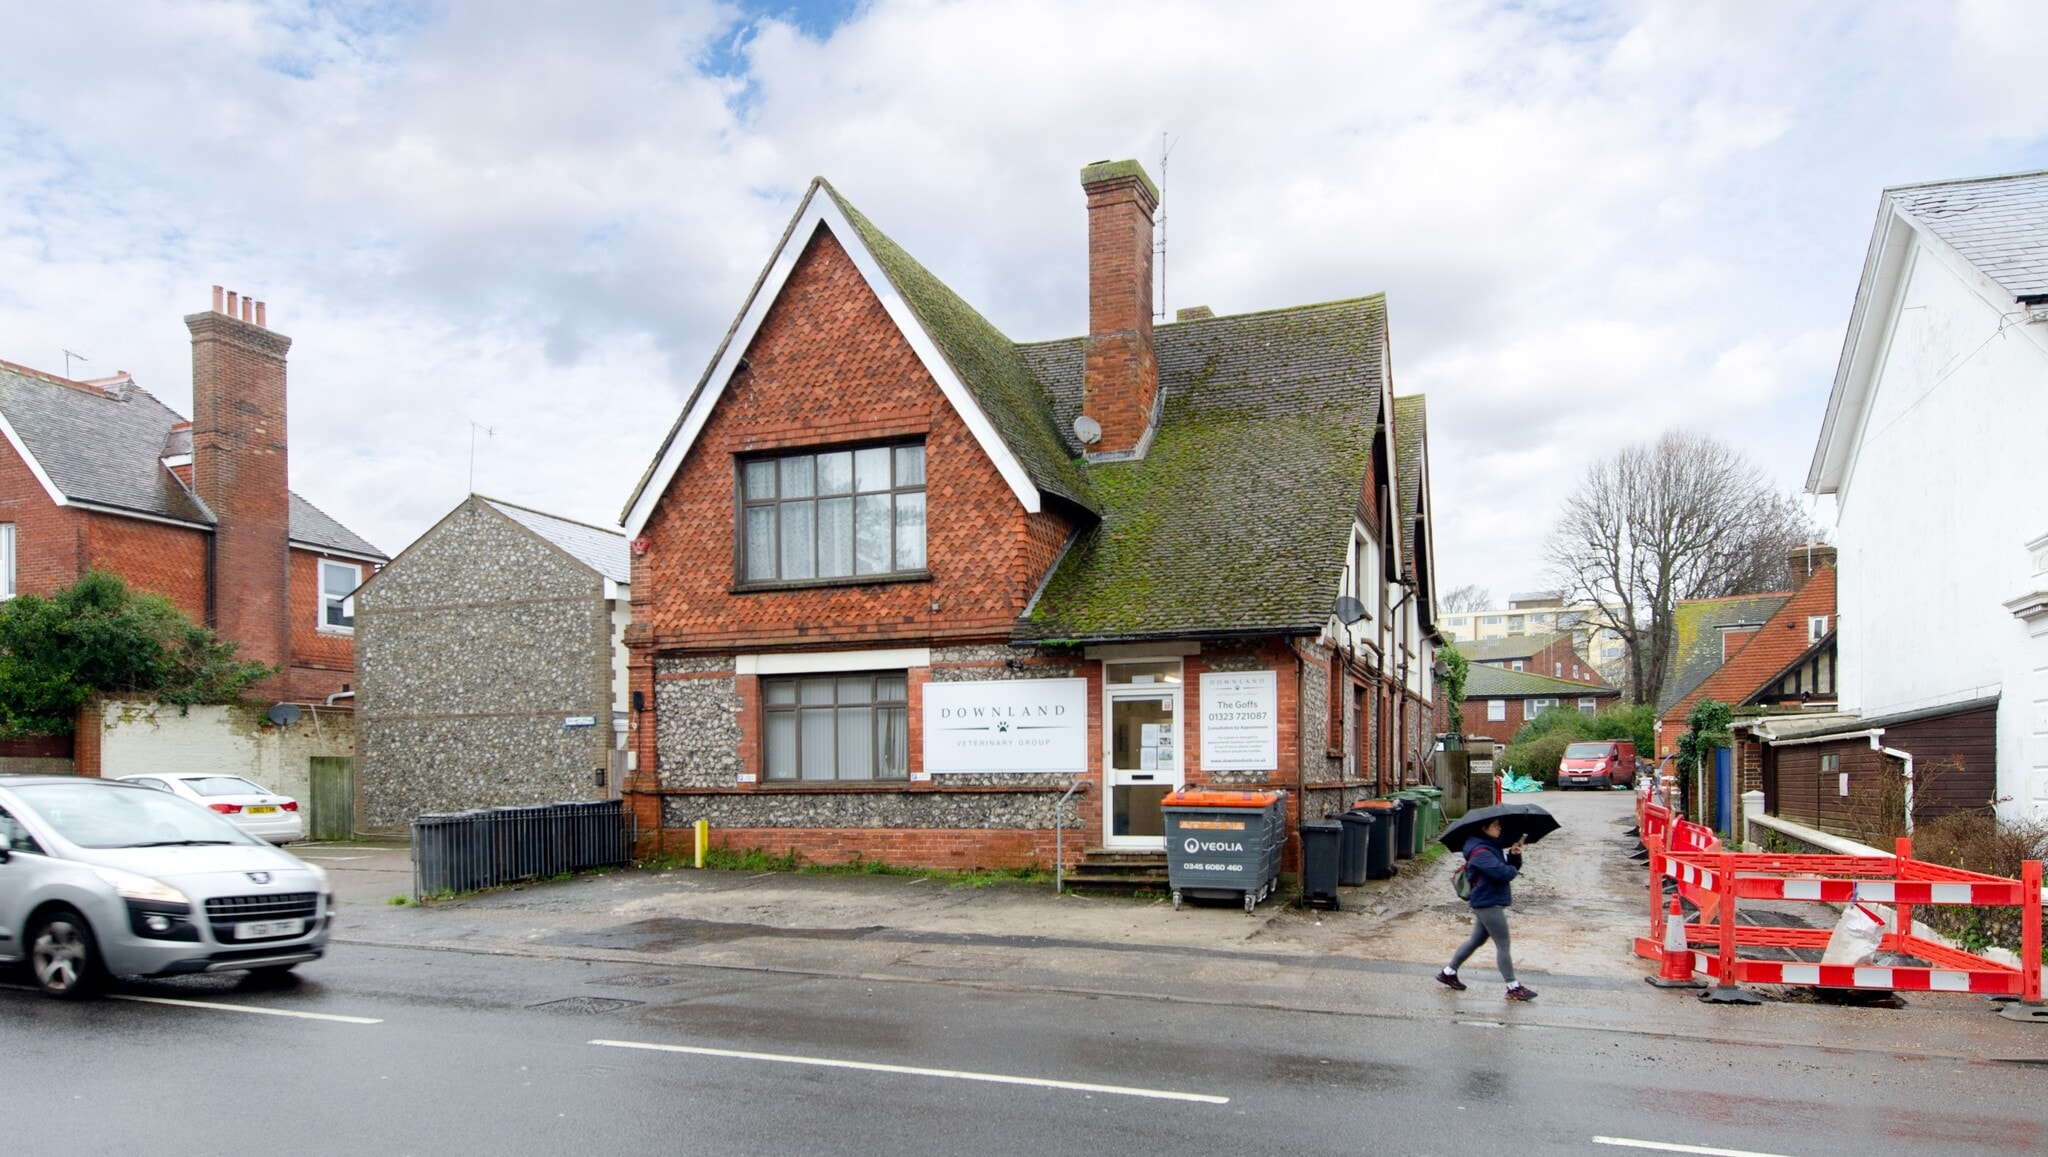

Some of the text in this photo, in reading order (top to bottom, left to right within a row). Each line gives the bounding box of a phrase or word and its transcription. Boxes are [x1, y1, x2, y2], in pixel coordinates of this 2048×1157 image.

[1218, 700, 1258, 709] The Goffs
[941, 705, 1065, 719] DOWNLAND
[1208, 712, 1267, 721] 01323 721087
[956, 738, 1051, 748] VETERINARY GROUP
[1200, 842, 1243, 852] VEOLIA
[1204, 863, 1226, 871] 6060
[1226, 864, 1243, 872] 460
